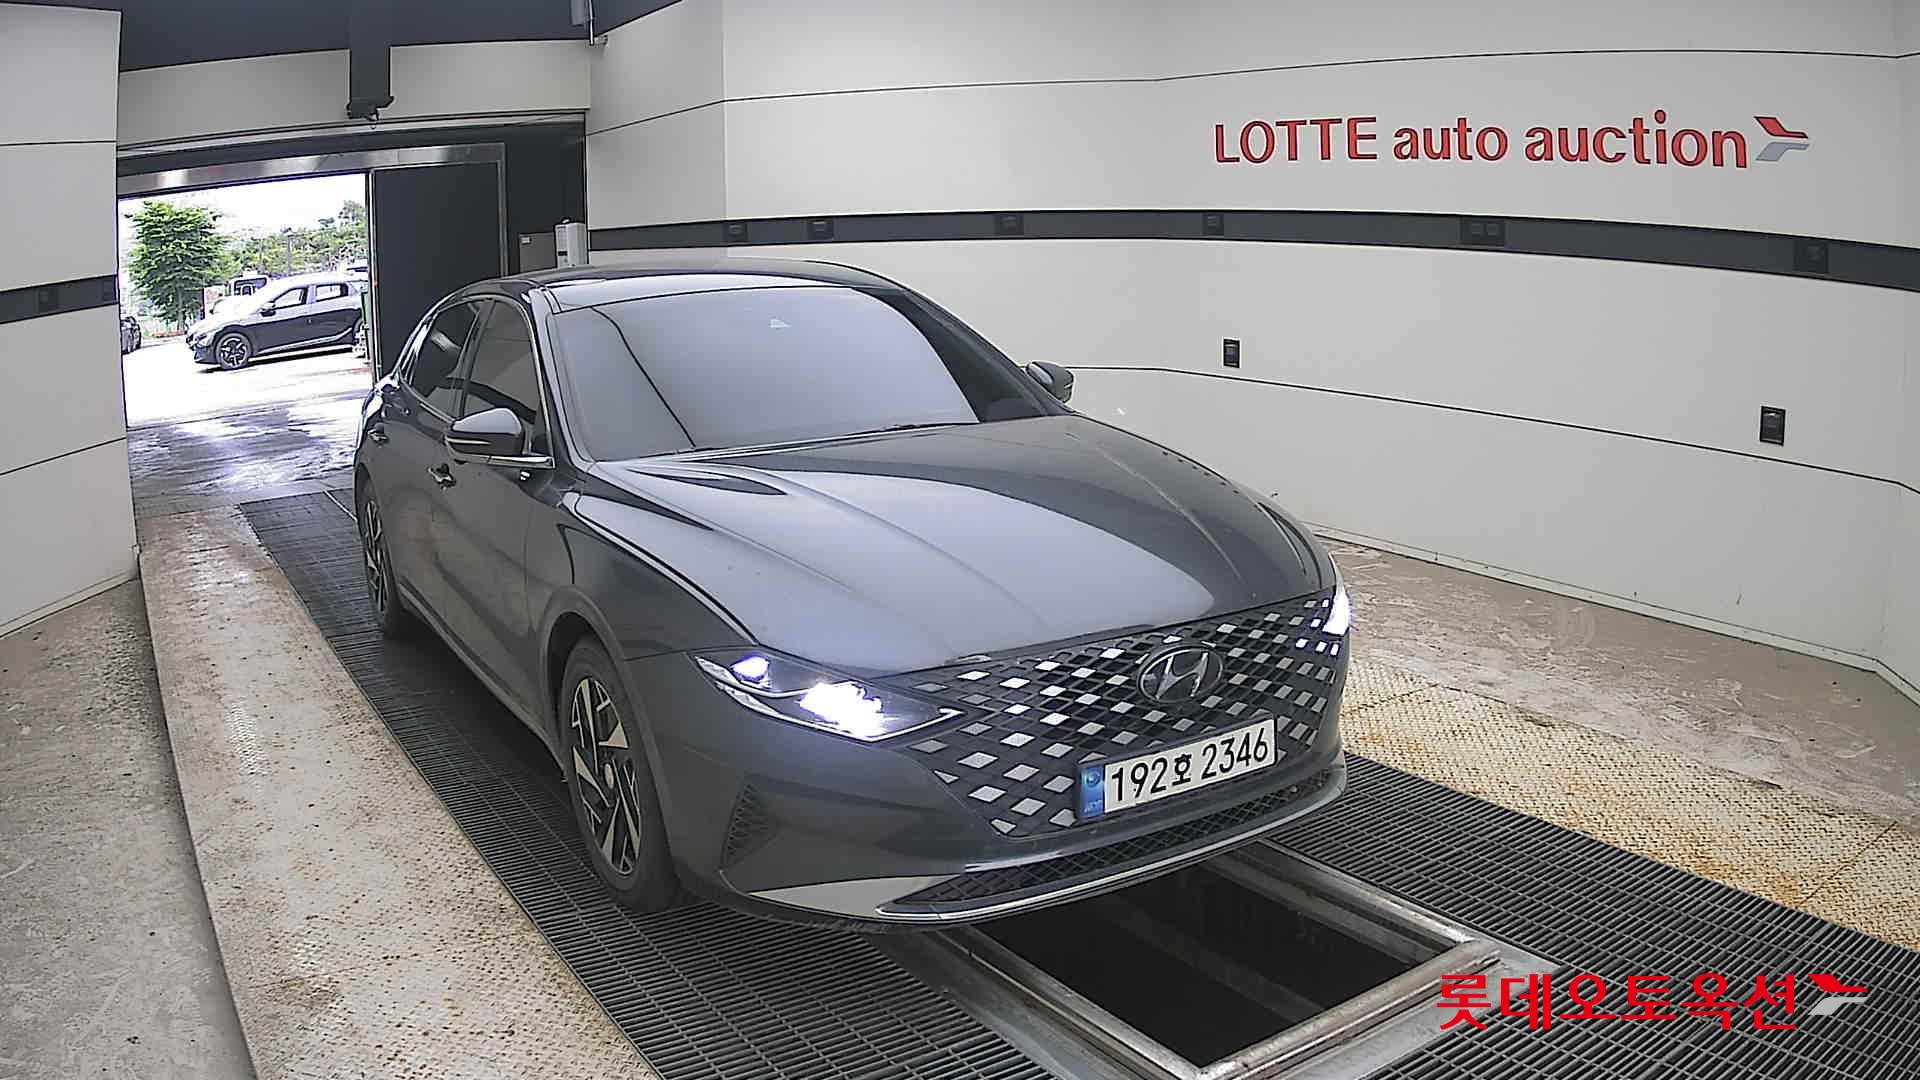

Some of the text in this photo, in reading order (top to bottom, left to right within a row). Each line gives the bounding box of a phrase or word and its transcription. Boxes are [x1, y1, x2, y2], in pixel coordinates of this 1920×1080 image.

[1214, 109, 1749, 169] LOTTE auto auction
[1111, 727, 1268, 802] 192호 2346
